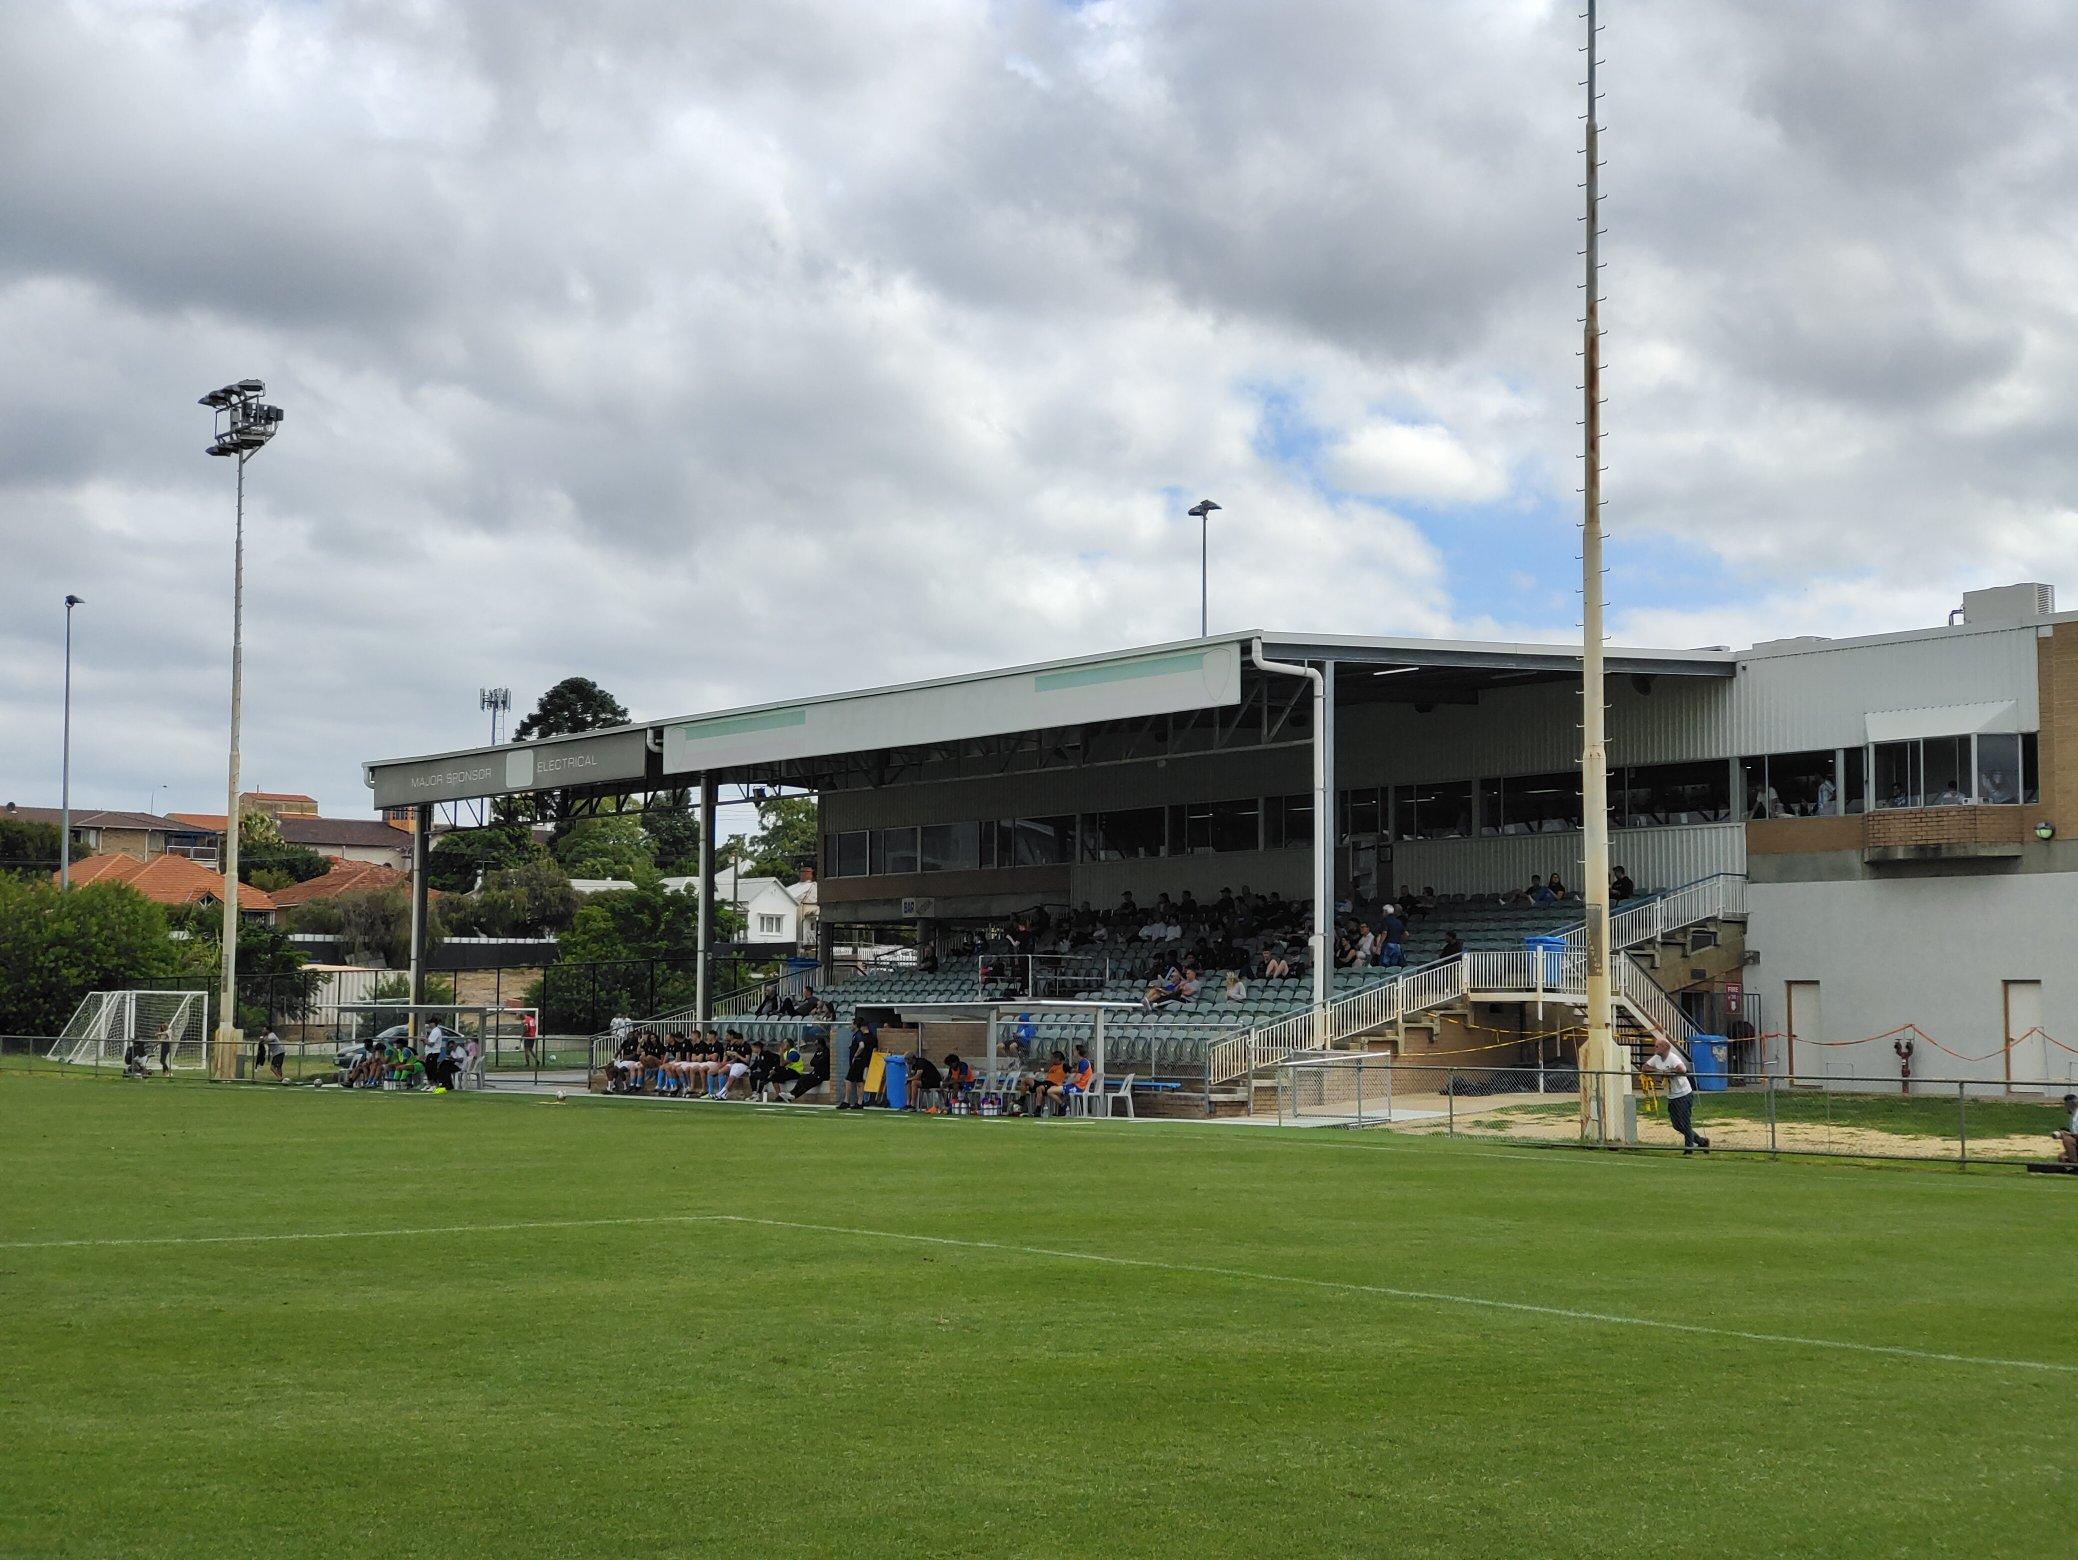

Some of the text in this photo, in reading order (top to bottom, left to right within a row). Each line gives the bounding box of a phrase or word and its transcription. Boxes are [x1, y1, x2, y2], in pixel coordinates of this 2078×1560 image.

[536, 755, 598, 772] ELECTRICAL
[411, 768, 492, 788] MAJOR SPONSOR
